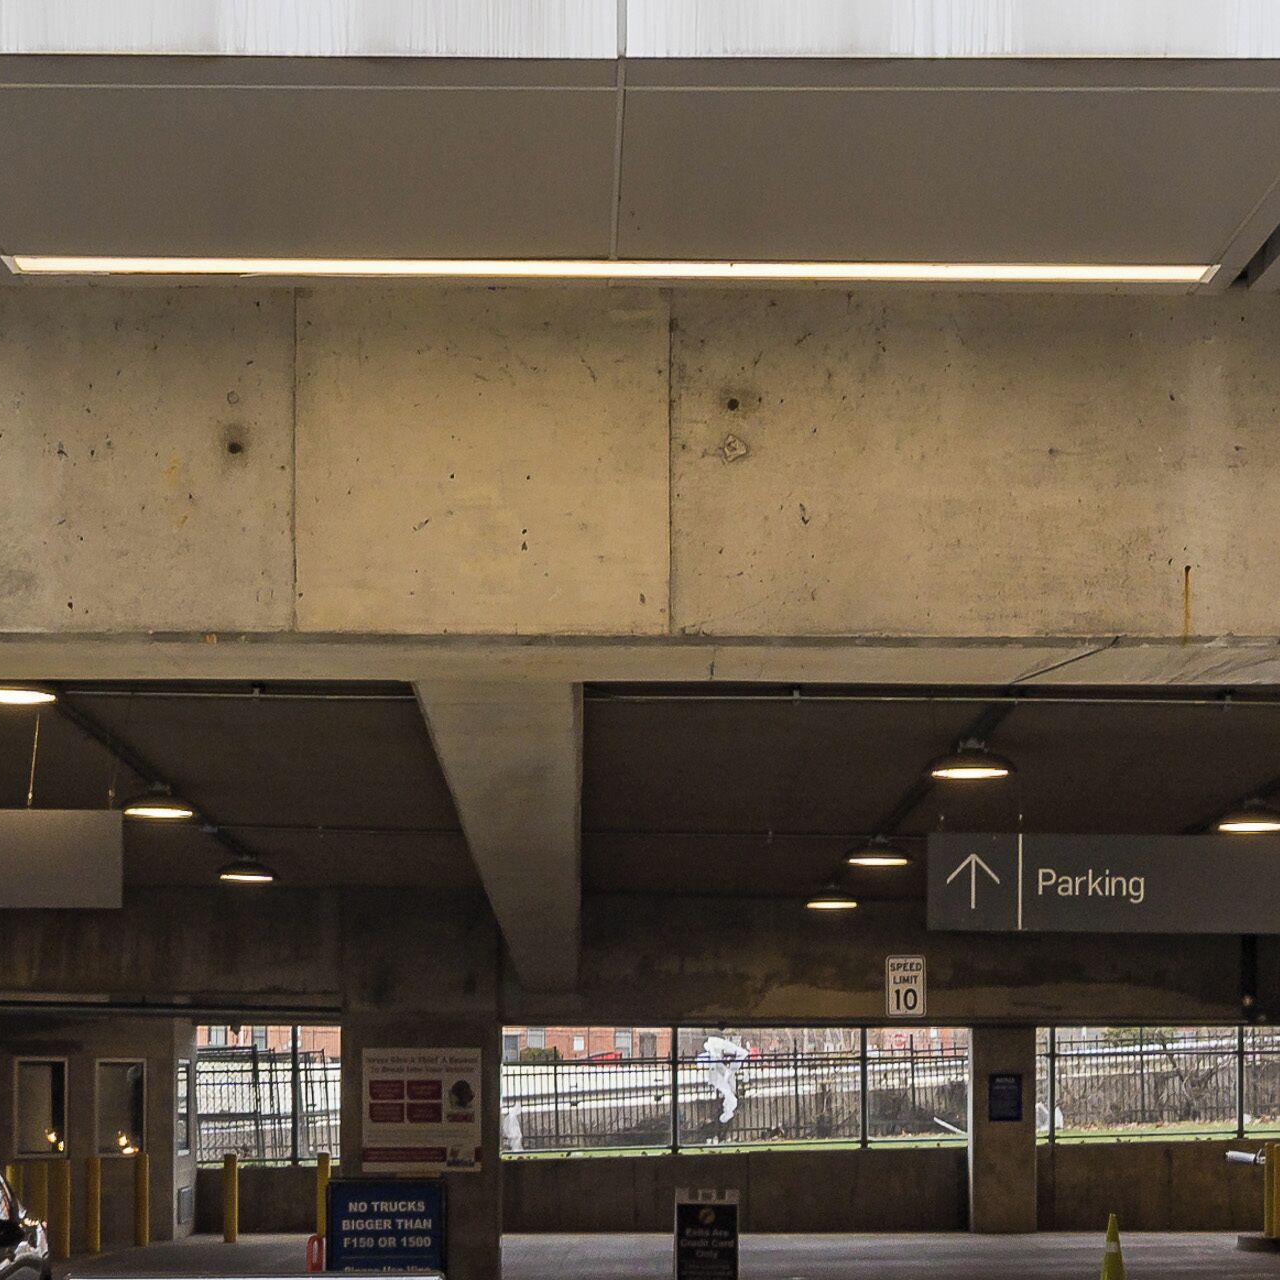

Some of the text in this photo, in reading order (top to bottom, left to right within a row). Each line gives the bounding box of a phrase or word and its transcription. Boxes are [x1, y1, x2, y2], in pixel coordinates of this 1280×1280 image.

[1037, 868, 1145, 904] Parking
[890, 962, 922, 972] SPEED
[893, 975, 919, 985] LIMIT
[894, 988, 918, 1011] 10
[348, 1201, 426, 1213] NO TRUCKS
[342, 1218, 433, 1231] BIGGER THAN
[343, 1236, 432, 1249] F150 OR 1500
